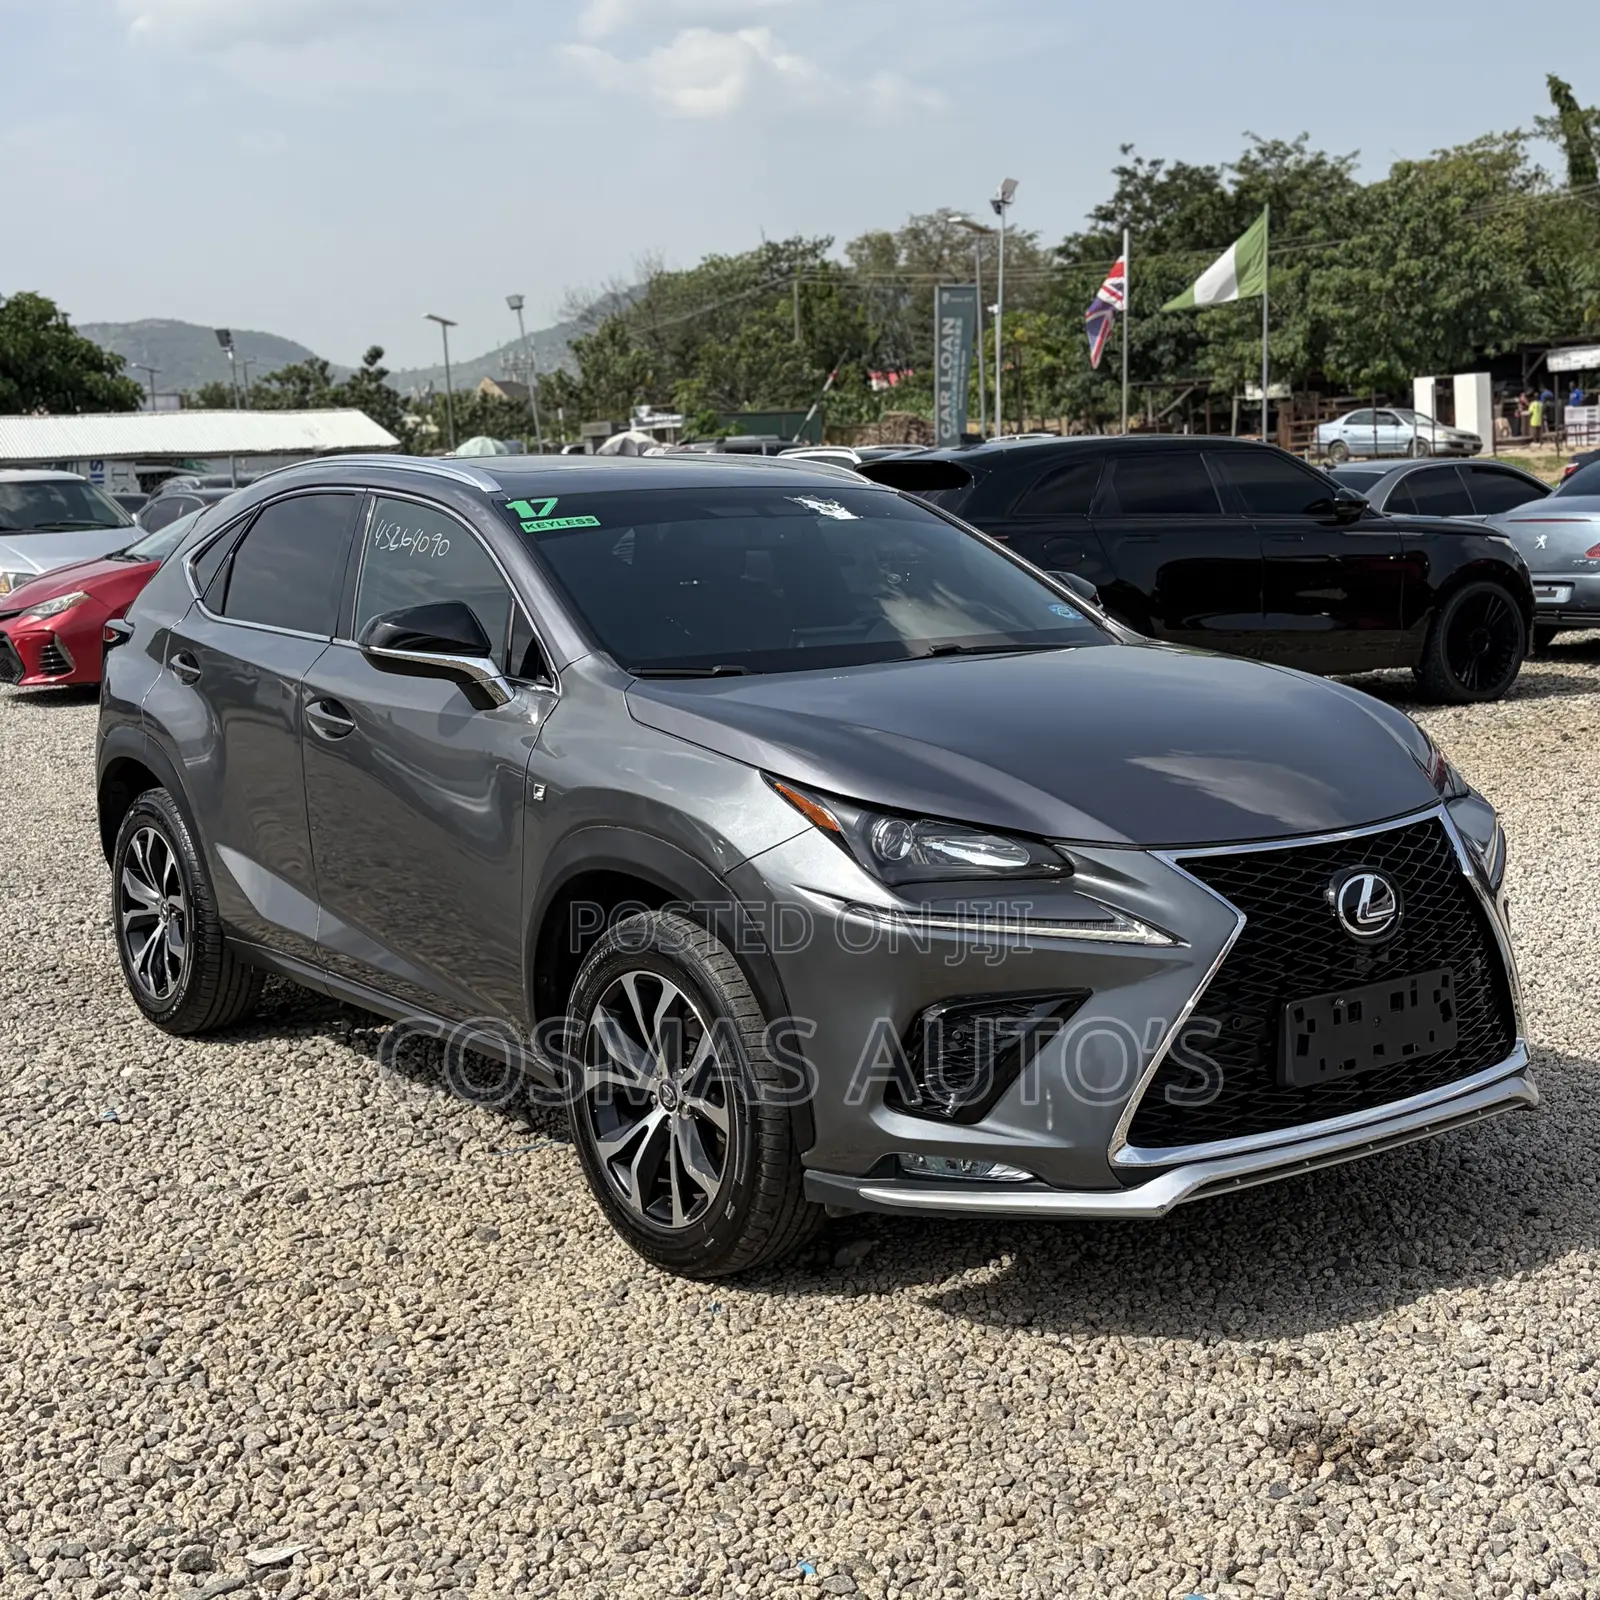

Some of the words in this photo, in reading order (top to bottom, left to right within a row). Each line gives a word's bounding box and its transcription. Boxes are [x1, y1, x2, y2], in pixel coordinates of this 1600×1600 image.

[940, 317, 955, 383] LOAN
[940, 390, 951, 439] CAR
[505, 497, 559, 519] 17
[524, 517, 596, 531] KEYLESS
